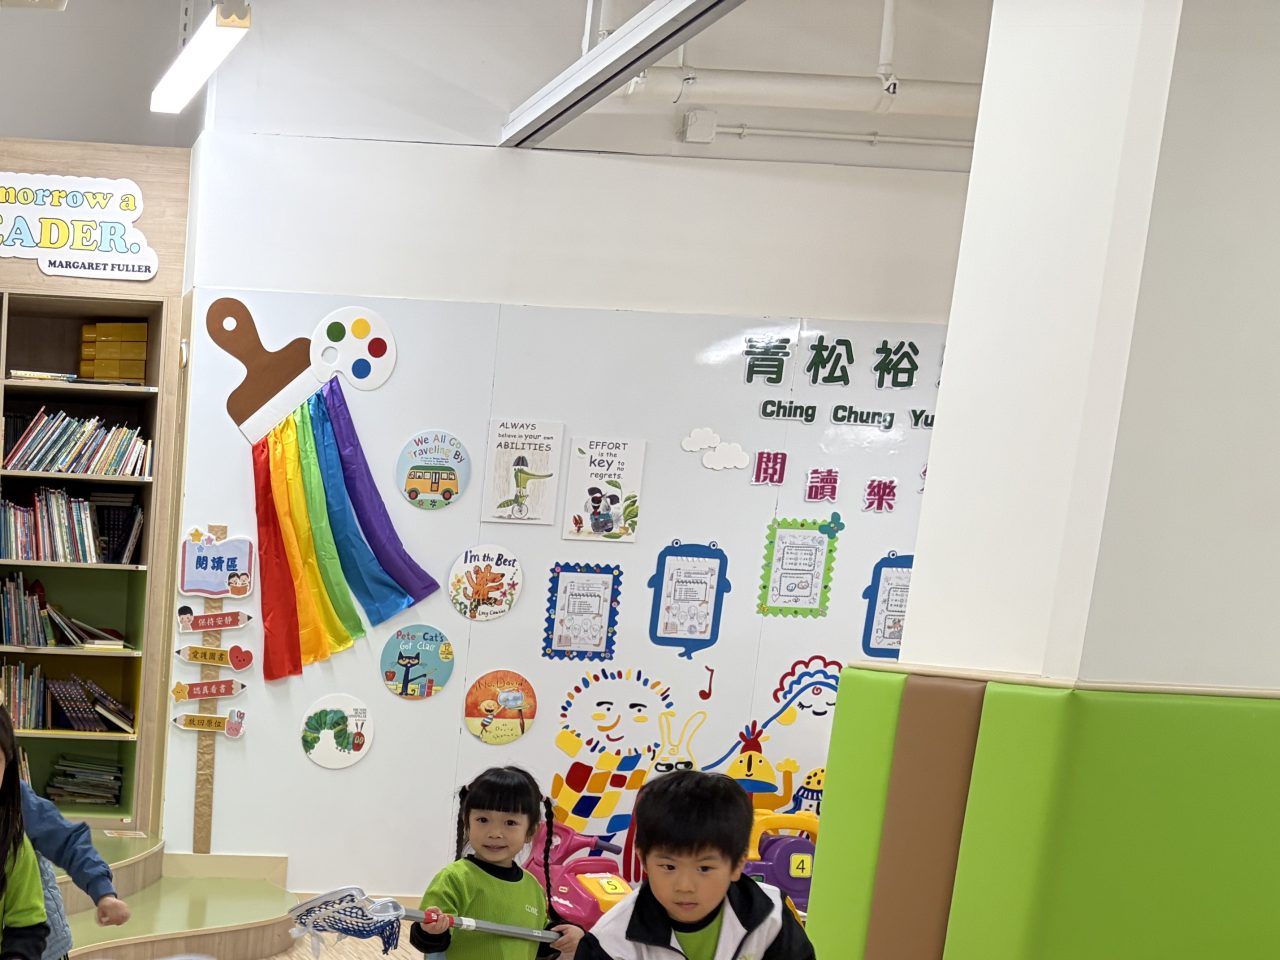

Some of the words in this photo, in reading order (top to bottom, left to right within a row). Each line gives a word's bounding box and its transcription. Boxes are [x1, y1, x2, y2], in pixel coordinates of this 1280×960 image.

[119, 193, 137, 211] a
[47, 259, 108, 272] MARGARET
[110, 262, 152, 274] FULLER
[744, 335, 946, 389] 青松裕
[762, 400, 817, 423] Ching
[832, 405, 895, 429] Chung
[499, 422, 537, 430] ALWAYS
[414, 436, 429, 447] We
[433, 434, 446, 444] All
[449, 437, 462, 449] Go
[496, 441, 552, 451] ABILITIES
[589, 441, 628, 450] EFFORT
[408, 445, 452, 459] Traveling
[453, 450, 465, 464] By
[589, 455, 614, 471] key
[590, 472, 623, 480] regrets.
[754, 451, 928, 512] 閱讀樂
[464, 550, 480, 564] I'm
[482, 553, 494, 562] the
[495, 553, 517, 567] Best
[396, 630, 416, 640] Pete
[423, 632, 444, 642] Cat's
[400, 640, 412, 650] Got
[796, 859, 806, 873] 4
[607, 880, 618, 891] 5
